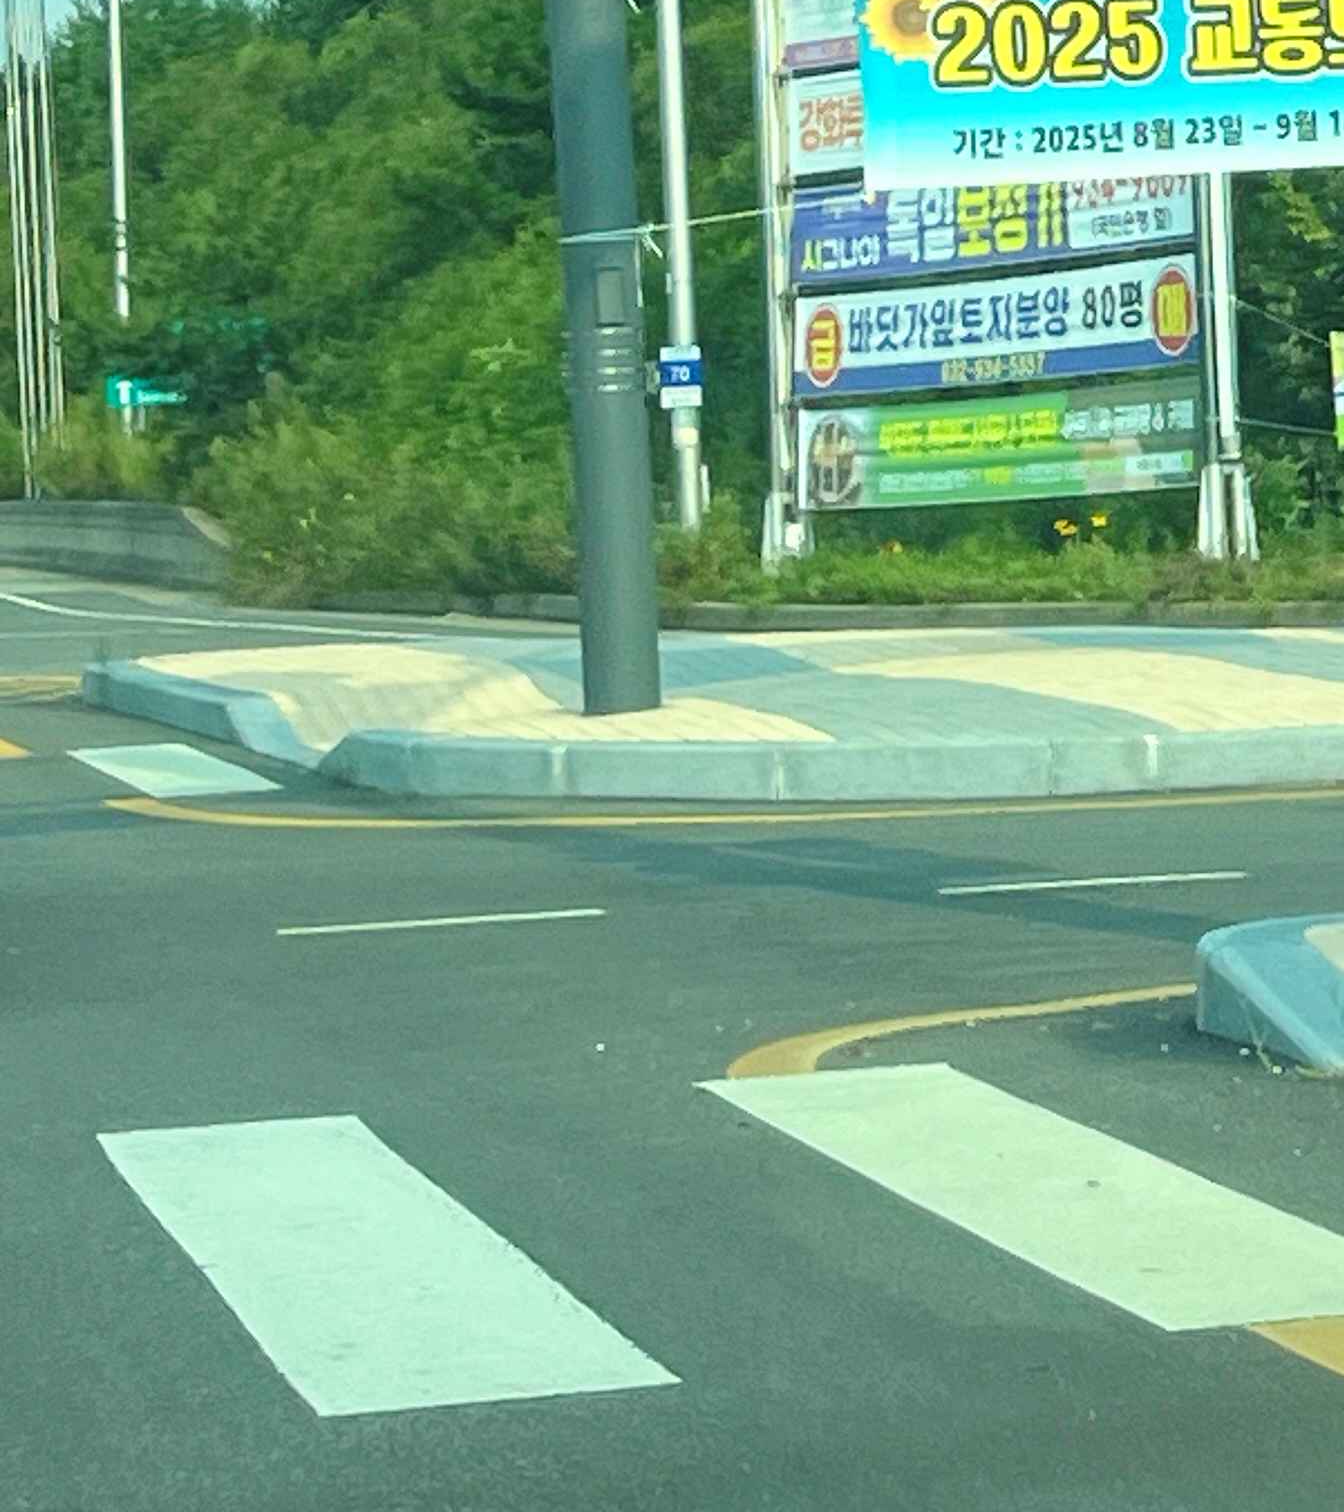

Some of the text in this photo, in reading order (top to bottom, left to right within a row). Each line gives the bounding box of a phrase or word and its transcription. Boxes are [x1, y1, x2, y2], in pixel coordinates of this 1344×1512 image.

[952, 128, 1006, 159] 기간
[1032, 123, 1125, 155] 2025년
[1133, 118, 1176, 150] 8월
[1184, 113, 1244, 147] 23일
[1276, 110, 1319, 143] 9월
[1081, 280, 1143, 330] 80평
